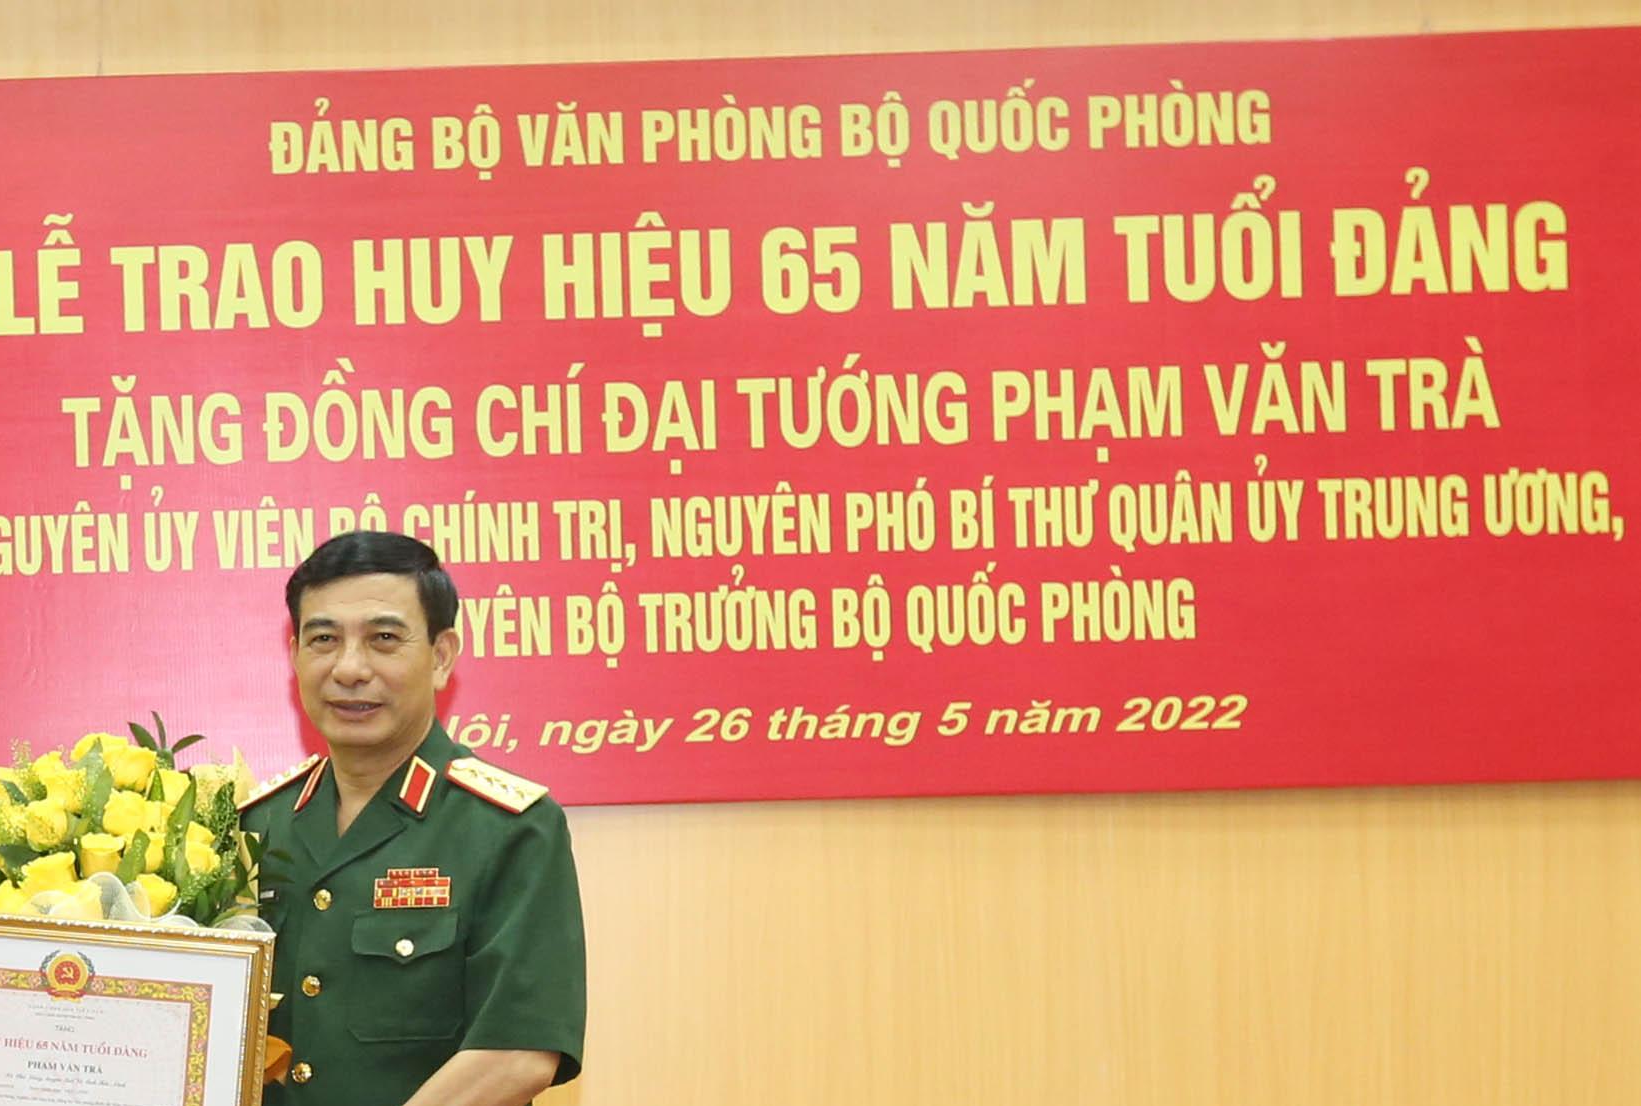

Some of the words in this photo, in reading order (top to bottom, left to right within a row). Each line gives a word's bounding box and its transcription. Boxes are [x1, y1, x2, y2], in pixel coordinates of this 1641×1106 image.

[268, 97, 414, 175] ĐẢNG
[432, 103, 501, 181] BỘ
[517, 101, 624, 167] VĂN
[641, 94, 822, 163] PHÒNG
[840, 90, 910, 168] BỘ
[928, 78, 1070, 161] QUỐC
[1088, 79, 1271, 149] PHÒNG
[110, 240, 323, 333] TRAO
[353, 235, 514, 326] HUY
[542, 211, 732, 338] HIỆU
[761, 226, 861, 314] 65
[890, 201, 1086, 310] NĂM
[1113, 174, 1302, 303] TUỔI
[1330, 167, 1568, 297] ĐẢNG
[61, 375, 244, 493] TẶNG
[262, 357, 454, 463] ĐỒNG
[476, 362, 585, 457] CHÍ
[601, 379, 717, 475] ĐẠI
[736, 353, 969, 449] TƯỚNG
[992, 366, 1183, 463] PHẠM
[1203, 341, 1346, 435] VĂN
[1366, 336, 1500, 430] TRÀ
[143, 485, 200, 572] ỦY
[212, 495, 315, 569] VIÊN
[552, 499, 636, 573] TRỊ,
[650, 481, 831, 558] NGUYÊN
[845, 477, 936, 553] PHÓ
[950, 475, 995, 550] BÍ
[1008, 479, 1099, 548] THƯ
[1108, 469, 1233, 552] QUÂN
[1247, 454, 1304, 542] ỦY
[1317, 475, 1469, 539] TRUNG
[1484, 468, 1624, 540] ƯƠNG,
[450, 583, 552, 658] YÊN
[566, 581, 625, 668] BỘ
[638, 564, 817, 653] TRƯỞNG
[832, 574, 891, 661] BỘ
[906, 561, 1026, 653] QUỐC
[1041, 565, 1196, 643] PHÒNG
[539, 709, 674, 754] ngày
[685, 707, 752, 742] 26
[767, 704, 922, 746] tháng
[937, 702, 972, 736] 5
[985, 700, 1101, 734] năm
[1116, 695, 1248, 731] 2022
